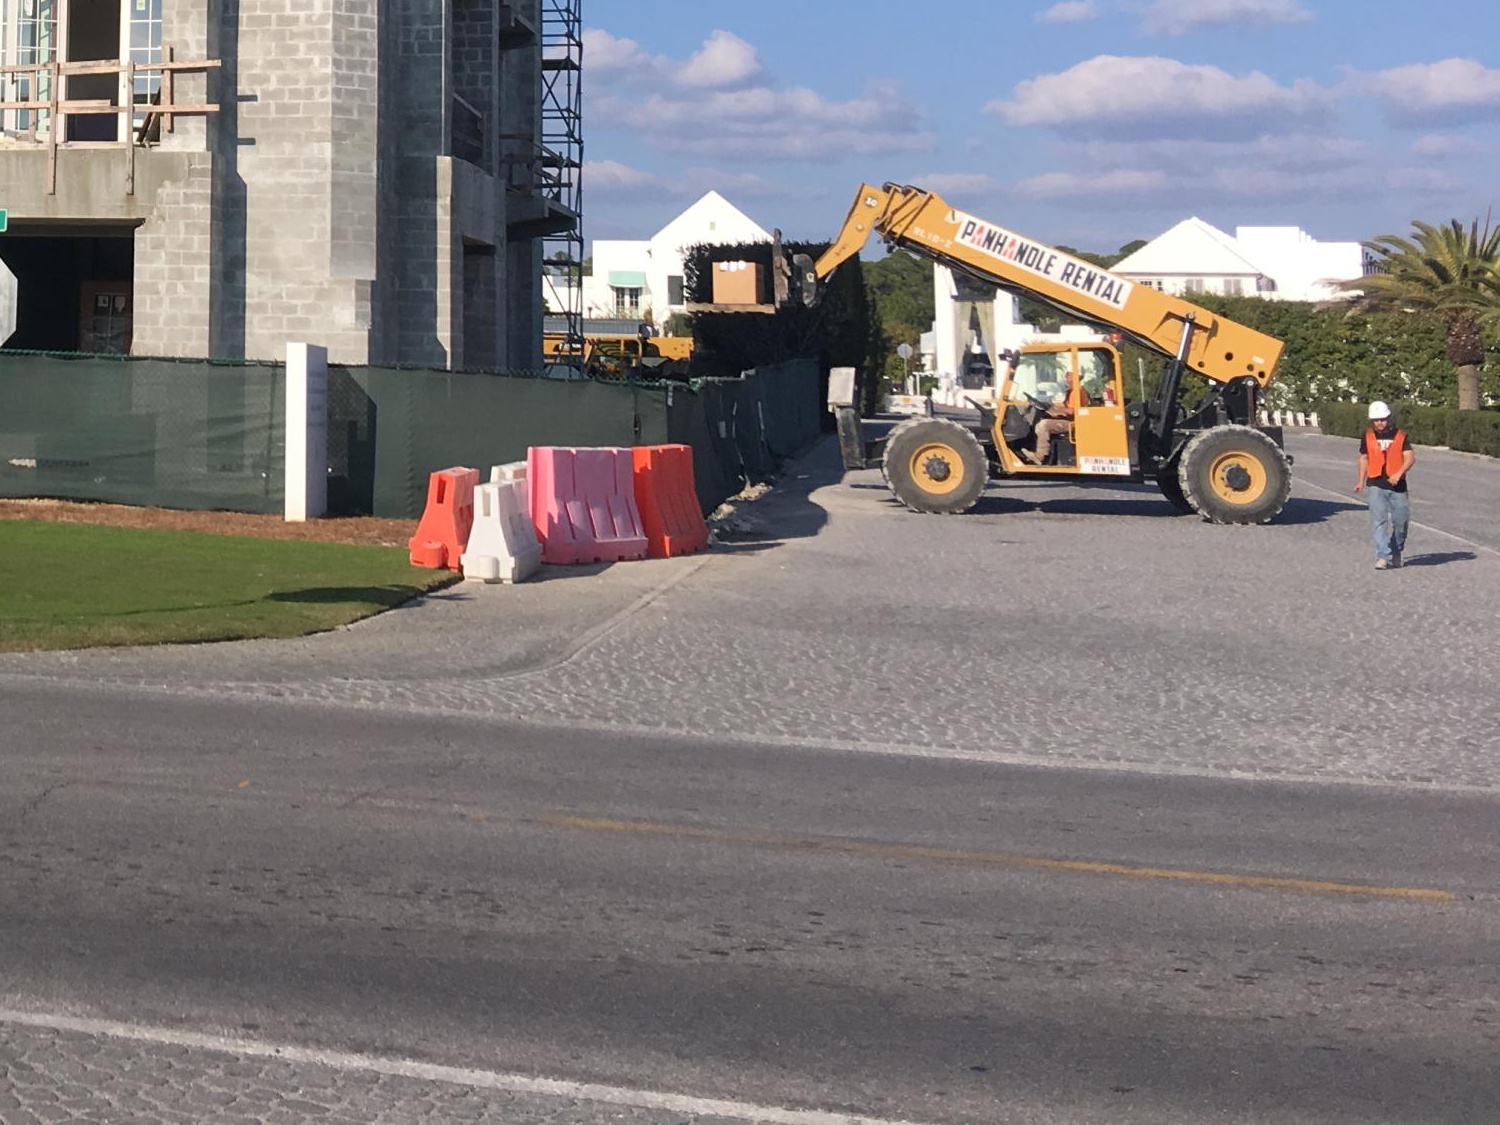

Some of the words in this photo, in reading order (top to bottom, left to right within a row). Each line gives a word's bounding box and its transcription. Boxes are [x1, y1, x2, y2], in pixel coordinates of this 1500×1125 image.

[961, 219, 1058, 276] PANHANDLE
[1060, 261, 1126, 305] RENTAL
[1084, 458, 1125, 466] PANHANDLE
